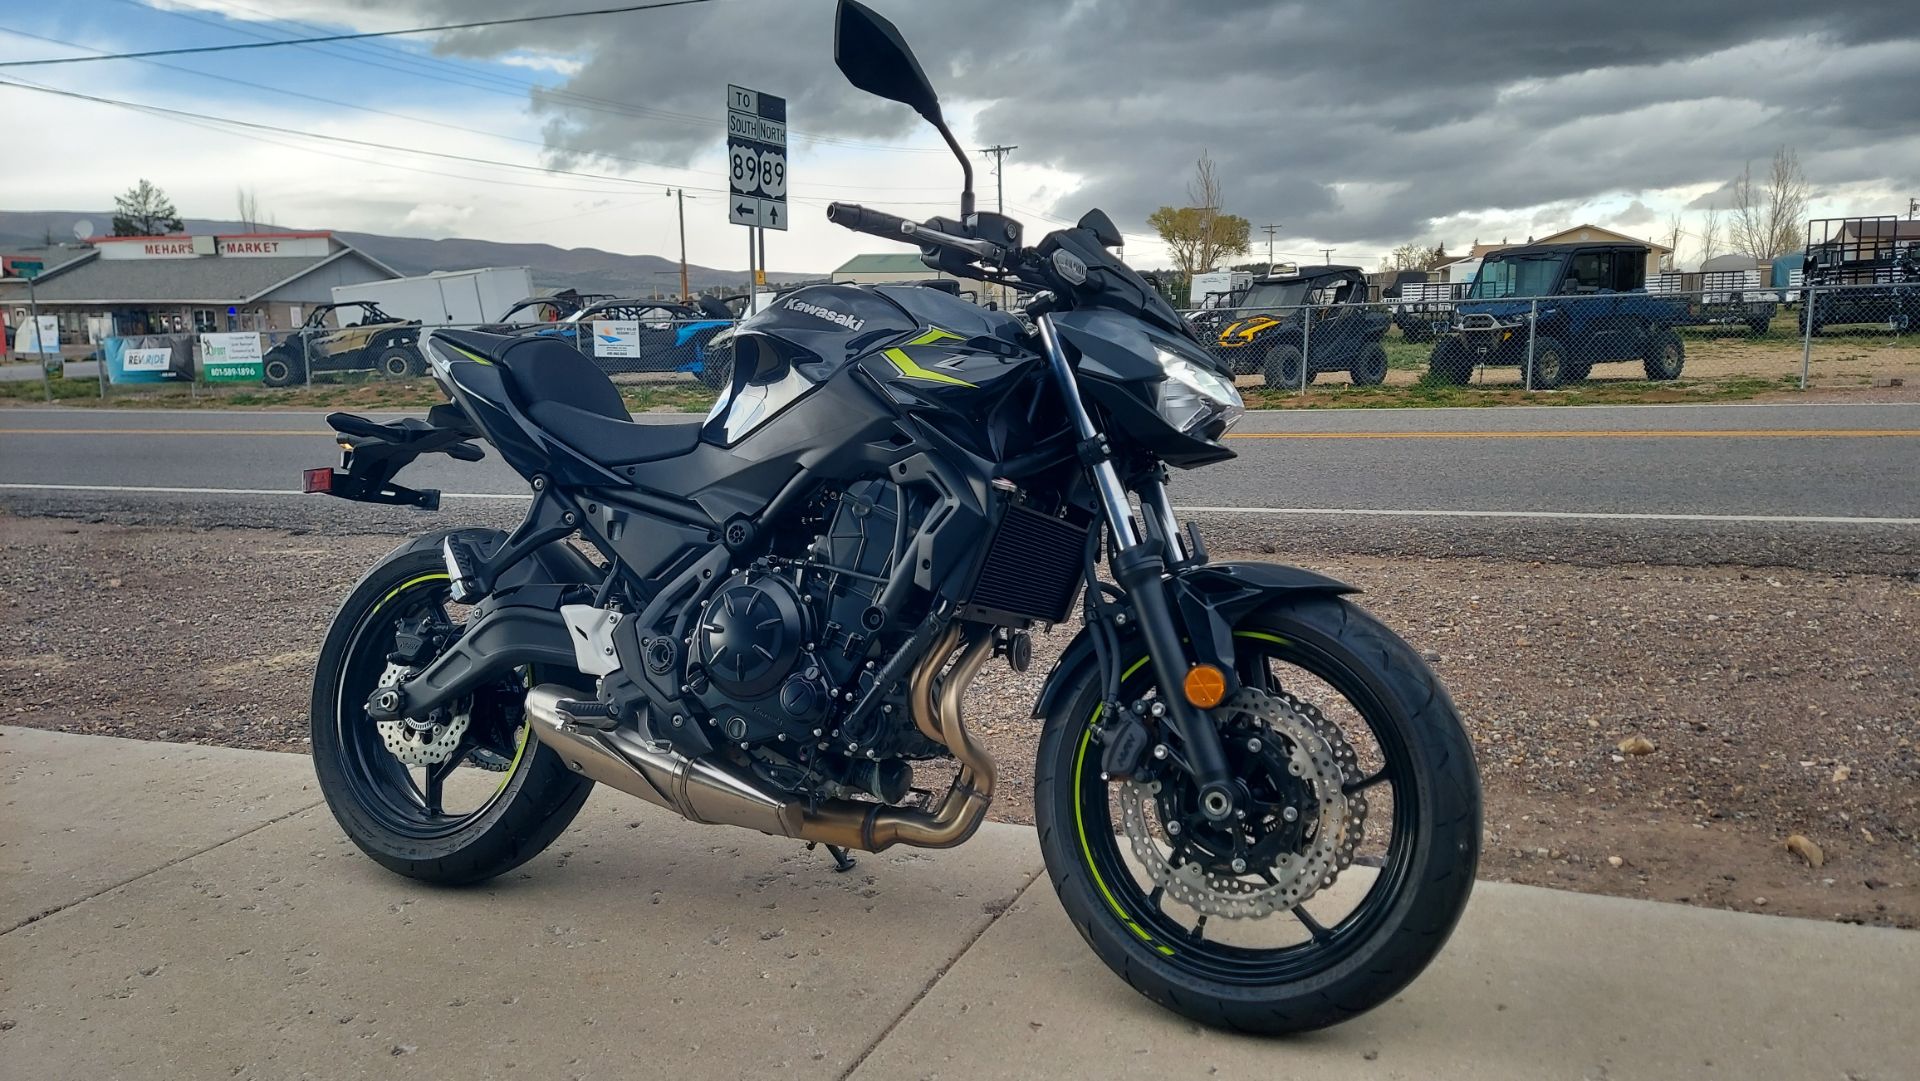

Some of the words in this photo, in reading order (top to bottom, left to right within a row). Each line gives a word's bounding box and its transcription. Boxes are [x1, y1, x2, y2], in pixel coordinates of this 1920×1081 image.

[736, 91, 751, 108] TO
[730, 115, 757, 137] SOUTH
[760, 121, 786, 143] NORTH
[733, 153, 757, 182] 89
[762, 160, 785, 187] 89
[144, 244, 193, 255] MEHAR'S
[226, 242, 279, 253] MARKET
[783, 298, 865, 332] Kawasaki
